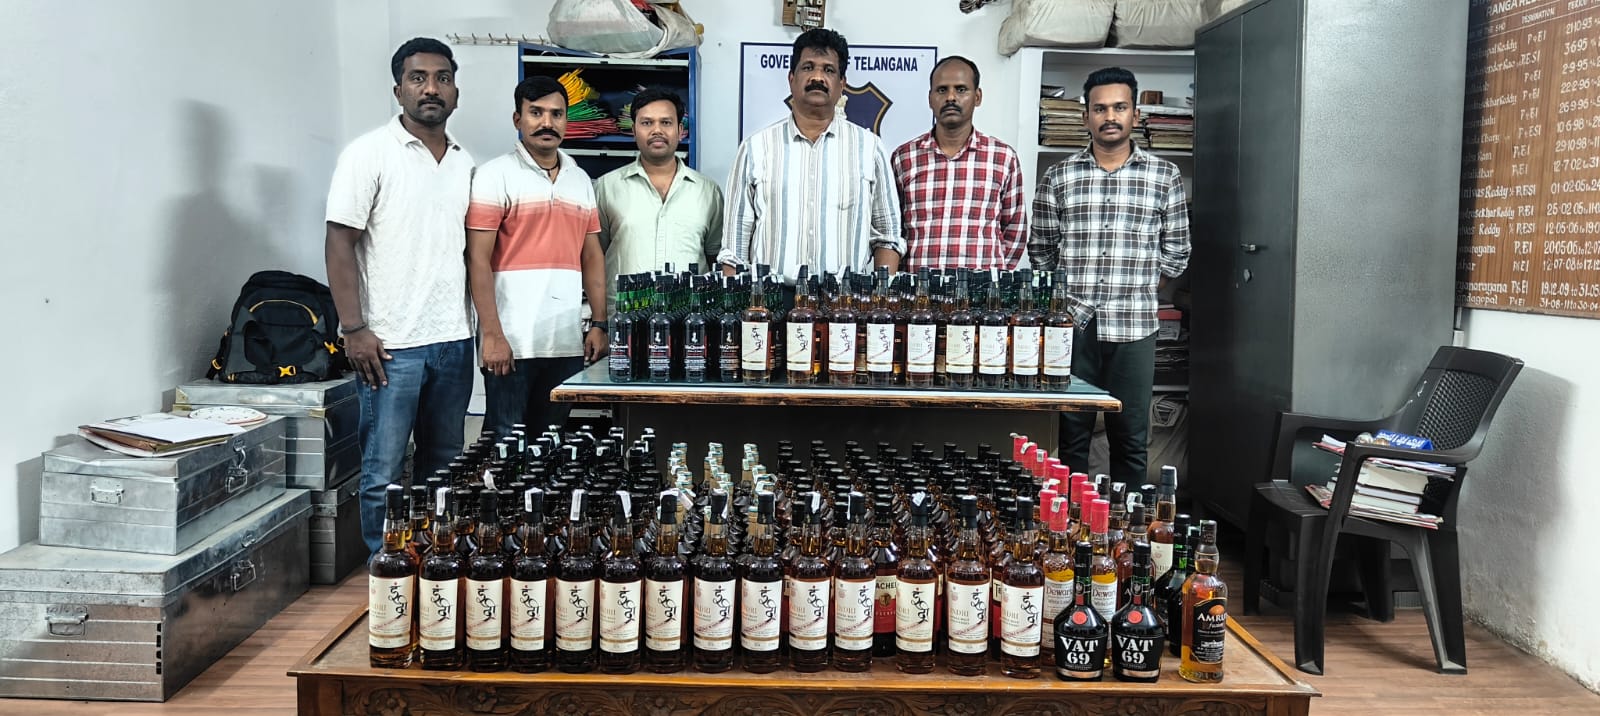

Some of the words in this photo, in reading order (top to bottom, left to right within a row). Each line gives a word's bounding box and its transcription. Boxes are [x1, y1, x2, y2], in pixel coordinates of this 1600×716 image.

[760, 53, 793, 69] GOVE
[854, 56, 918, 72] TELANGANA
[1059, 636, 1099, 653] VAT
[1115, 634, 1153, 652] VAT
[1066, 652, 1090, 665] 69
[1121, 650, 1145, 664] 69
